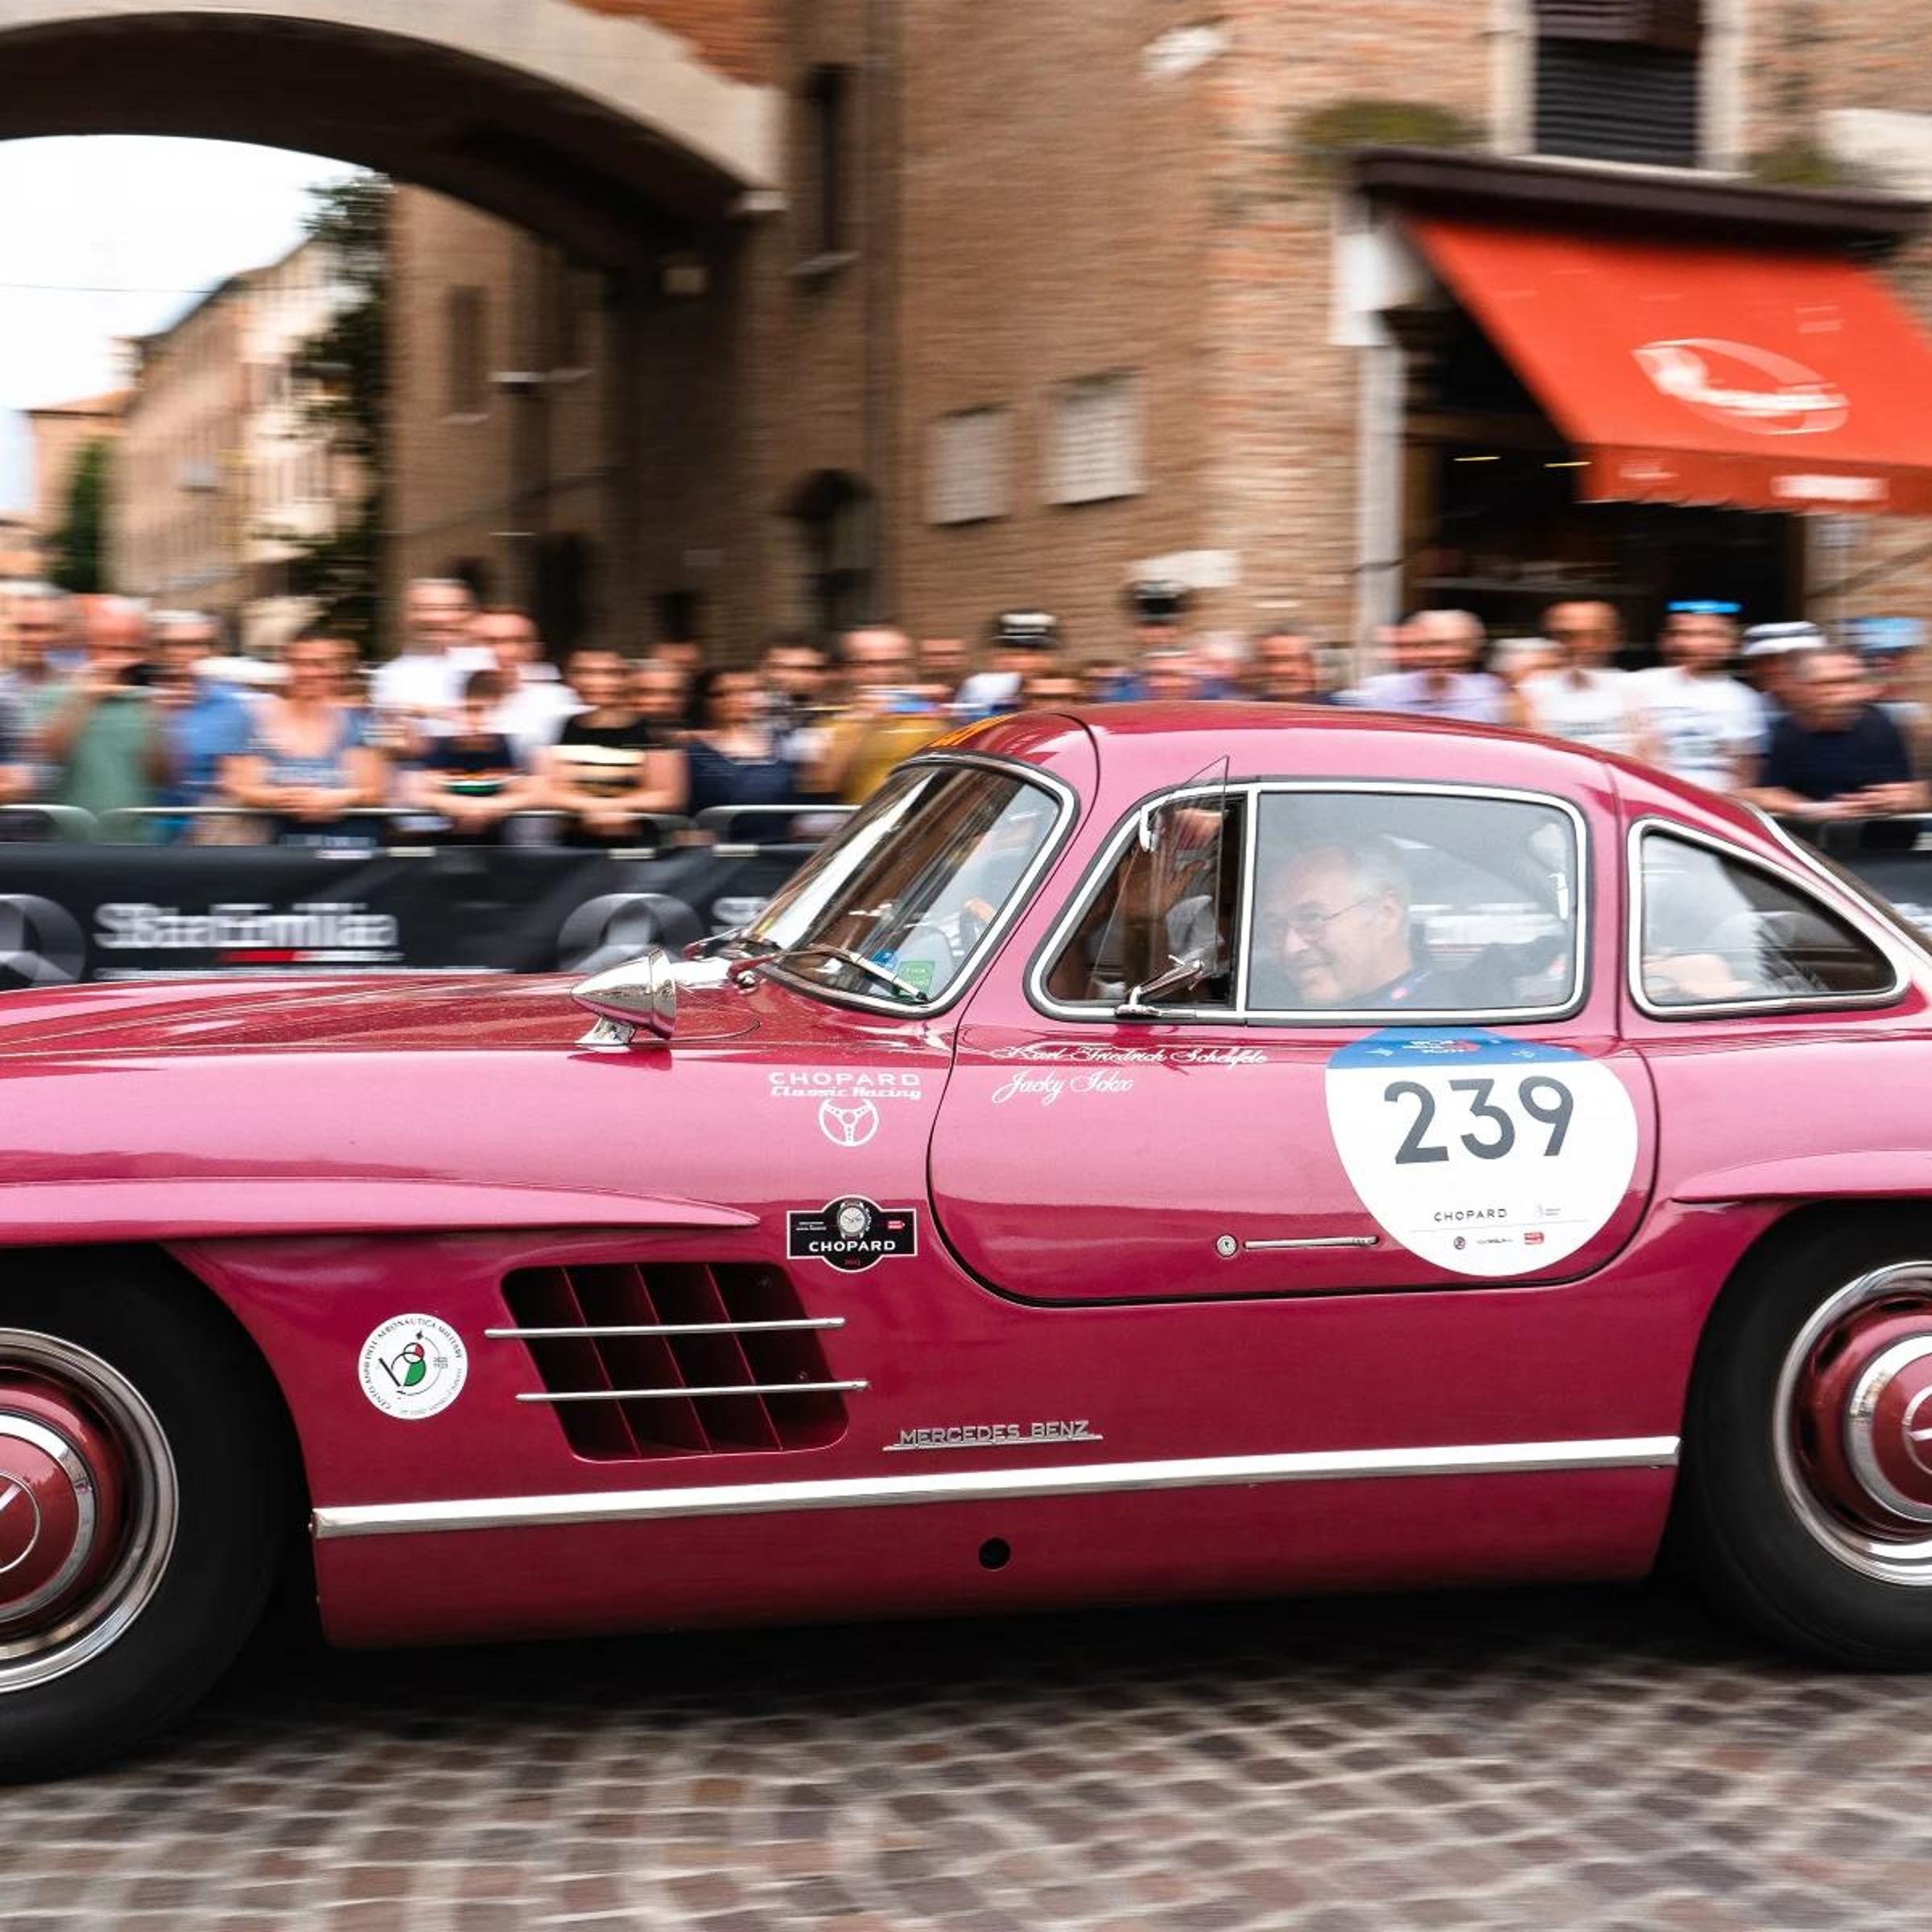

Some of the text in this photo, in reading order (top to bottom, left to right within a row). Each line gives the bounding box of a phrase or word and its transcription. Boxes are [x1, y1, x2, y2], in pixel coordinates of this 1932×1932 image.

[768, 1071, 922, 1086] CHOPARD
[770, 1086, 848, 1098] Classic
[991, 1068, 1066, 1108] Jacky
[1383, 1075, 1575, 1166] 239
[1434, 1208, 1508, 1222] CHOPARD
[808, 1240, 896, 1253] CHOPARD
[899, 1420, 1089, 1445] MERCEDES BENZ
